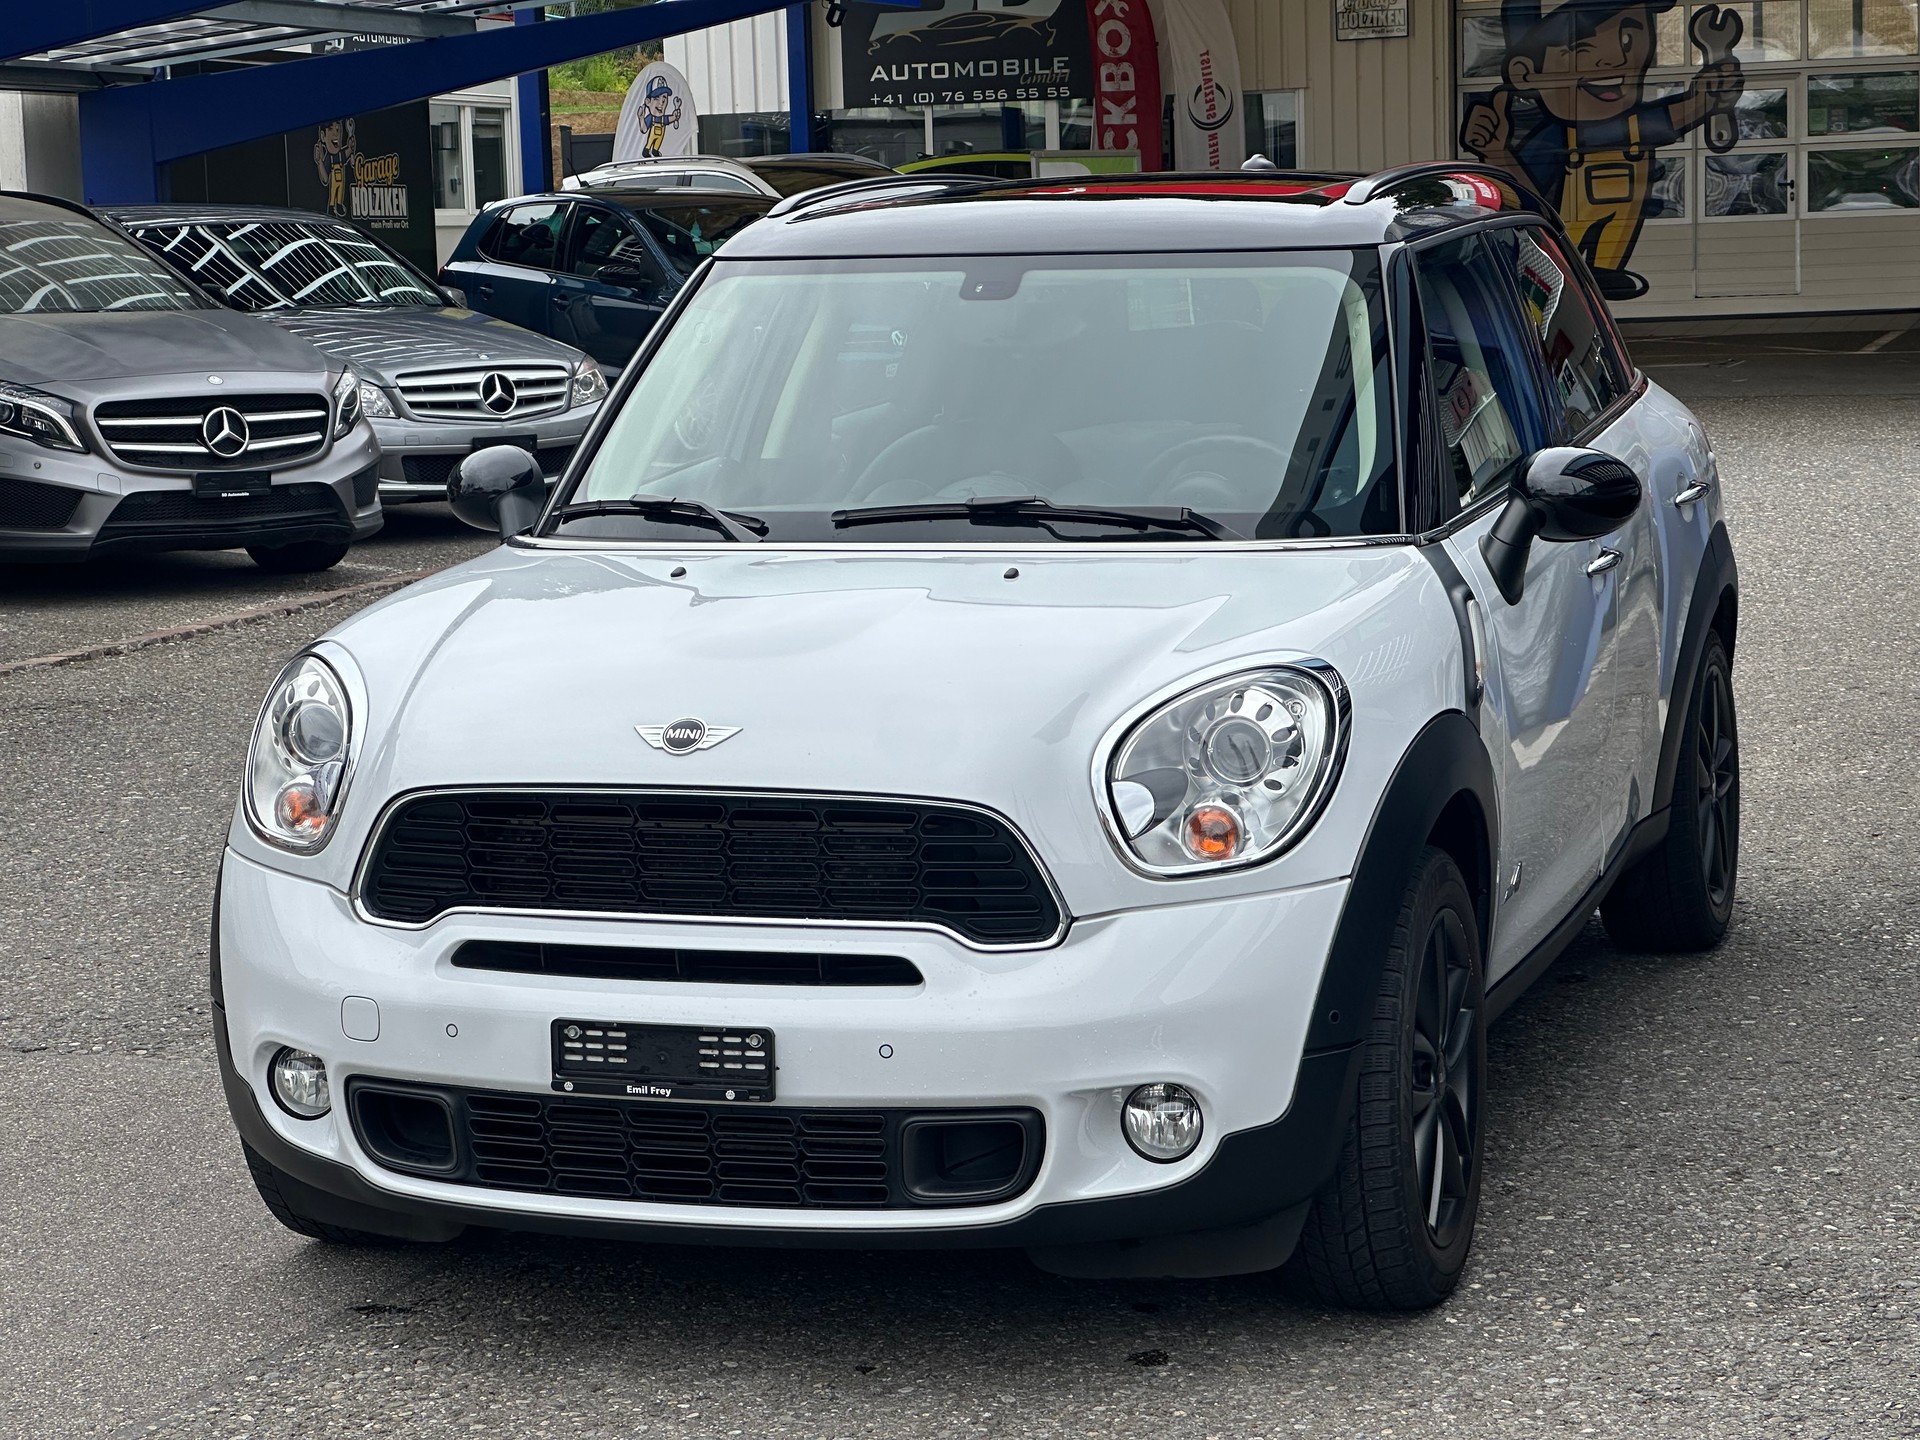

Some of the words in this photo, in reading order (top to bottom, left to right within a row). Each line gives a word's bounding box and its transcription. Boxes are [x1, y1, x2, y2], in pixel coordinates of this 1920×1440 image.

[1338, 9, 1405, 29] HOLZIKEN
[870, 56, 1069, 82] AUTOMOBILE
[870, 93, 903, 105] +41
[942, 91, 965, 102] 76
[973, 88, 1008, 101] 556
[1016, 88, 1039, 99] 55
[1047, 86, 1071, 97] 55
[354, 153, 400, 187] Garage
[351, 186, 407, 217] HOLZIKEN
[400, 219, 409, 229] Ort
[666, 728, 701, 740] MINI
[626, 1085, 648, 1094] Emil
[650, 1086, 671, 1097] Frey
